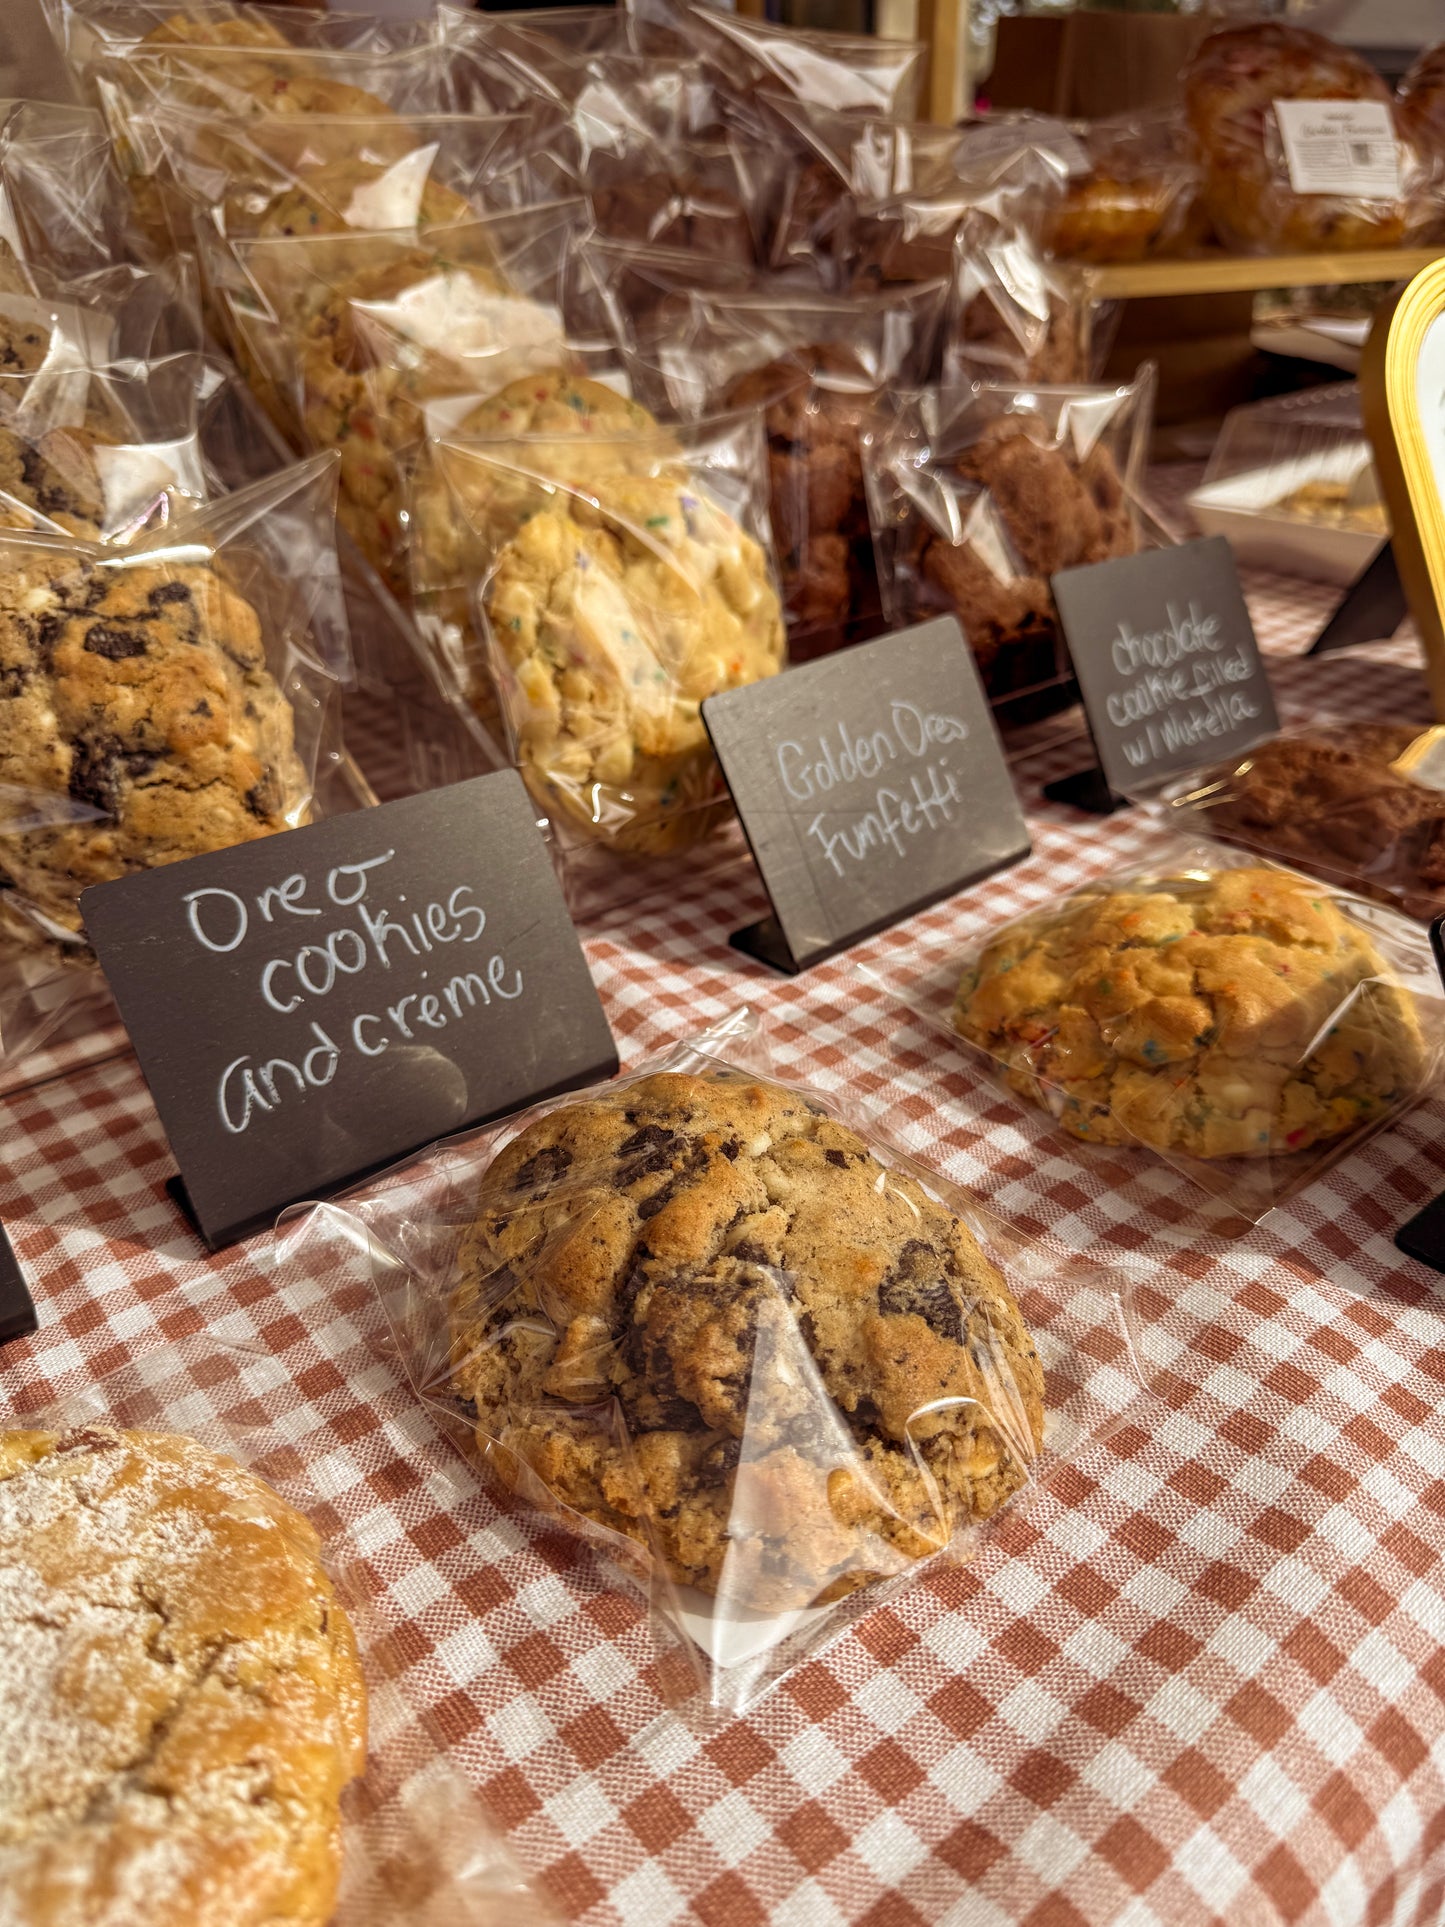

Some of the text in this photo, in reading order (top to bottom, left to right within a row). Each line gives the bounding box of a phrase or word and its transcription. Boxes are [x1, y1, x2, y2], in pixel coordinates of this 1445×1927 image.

[1106, 642, 1255, 727] cookie filled
[1111, 602, 1223, 676] chocolate
[780, 722, 898, 800] Golden
[1159, 690, 1262, 755] Nutella
[808, 756, 963, 877] Funfetti
[182, 848, 395, 952] Oreo
[261, 885, 486, 1013] cookies
[218, 1021, 340, 1134] and
